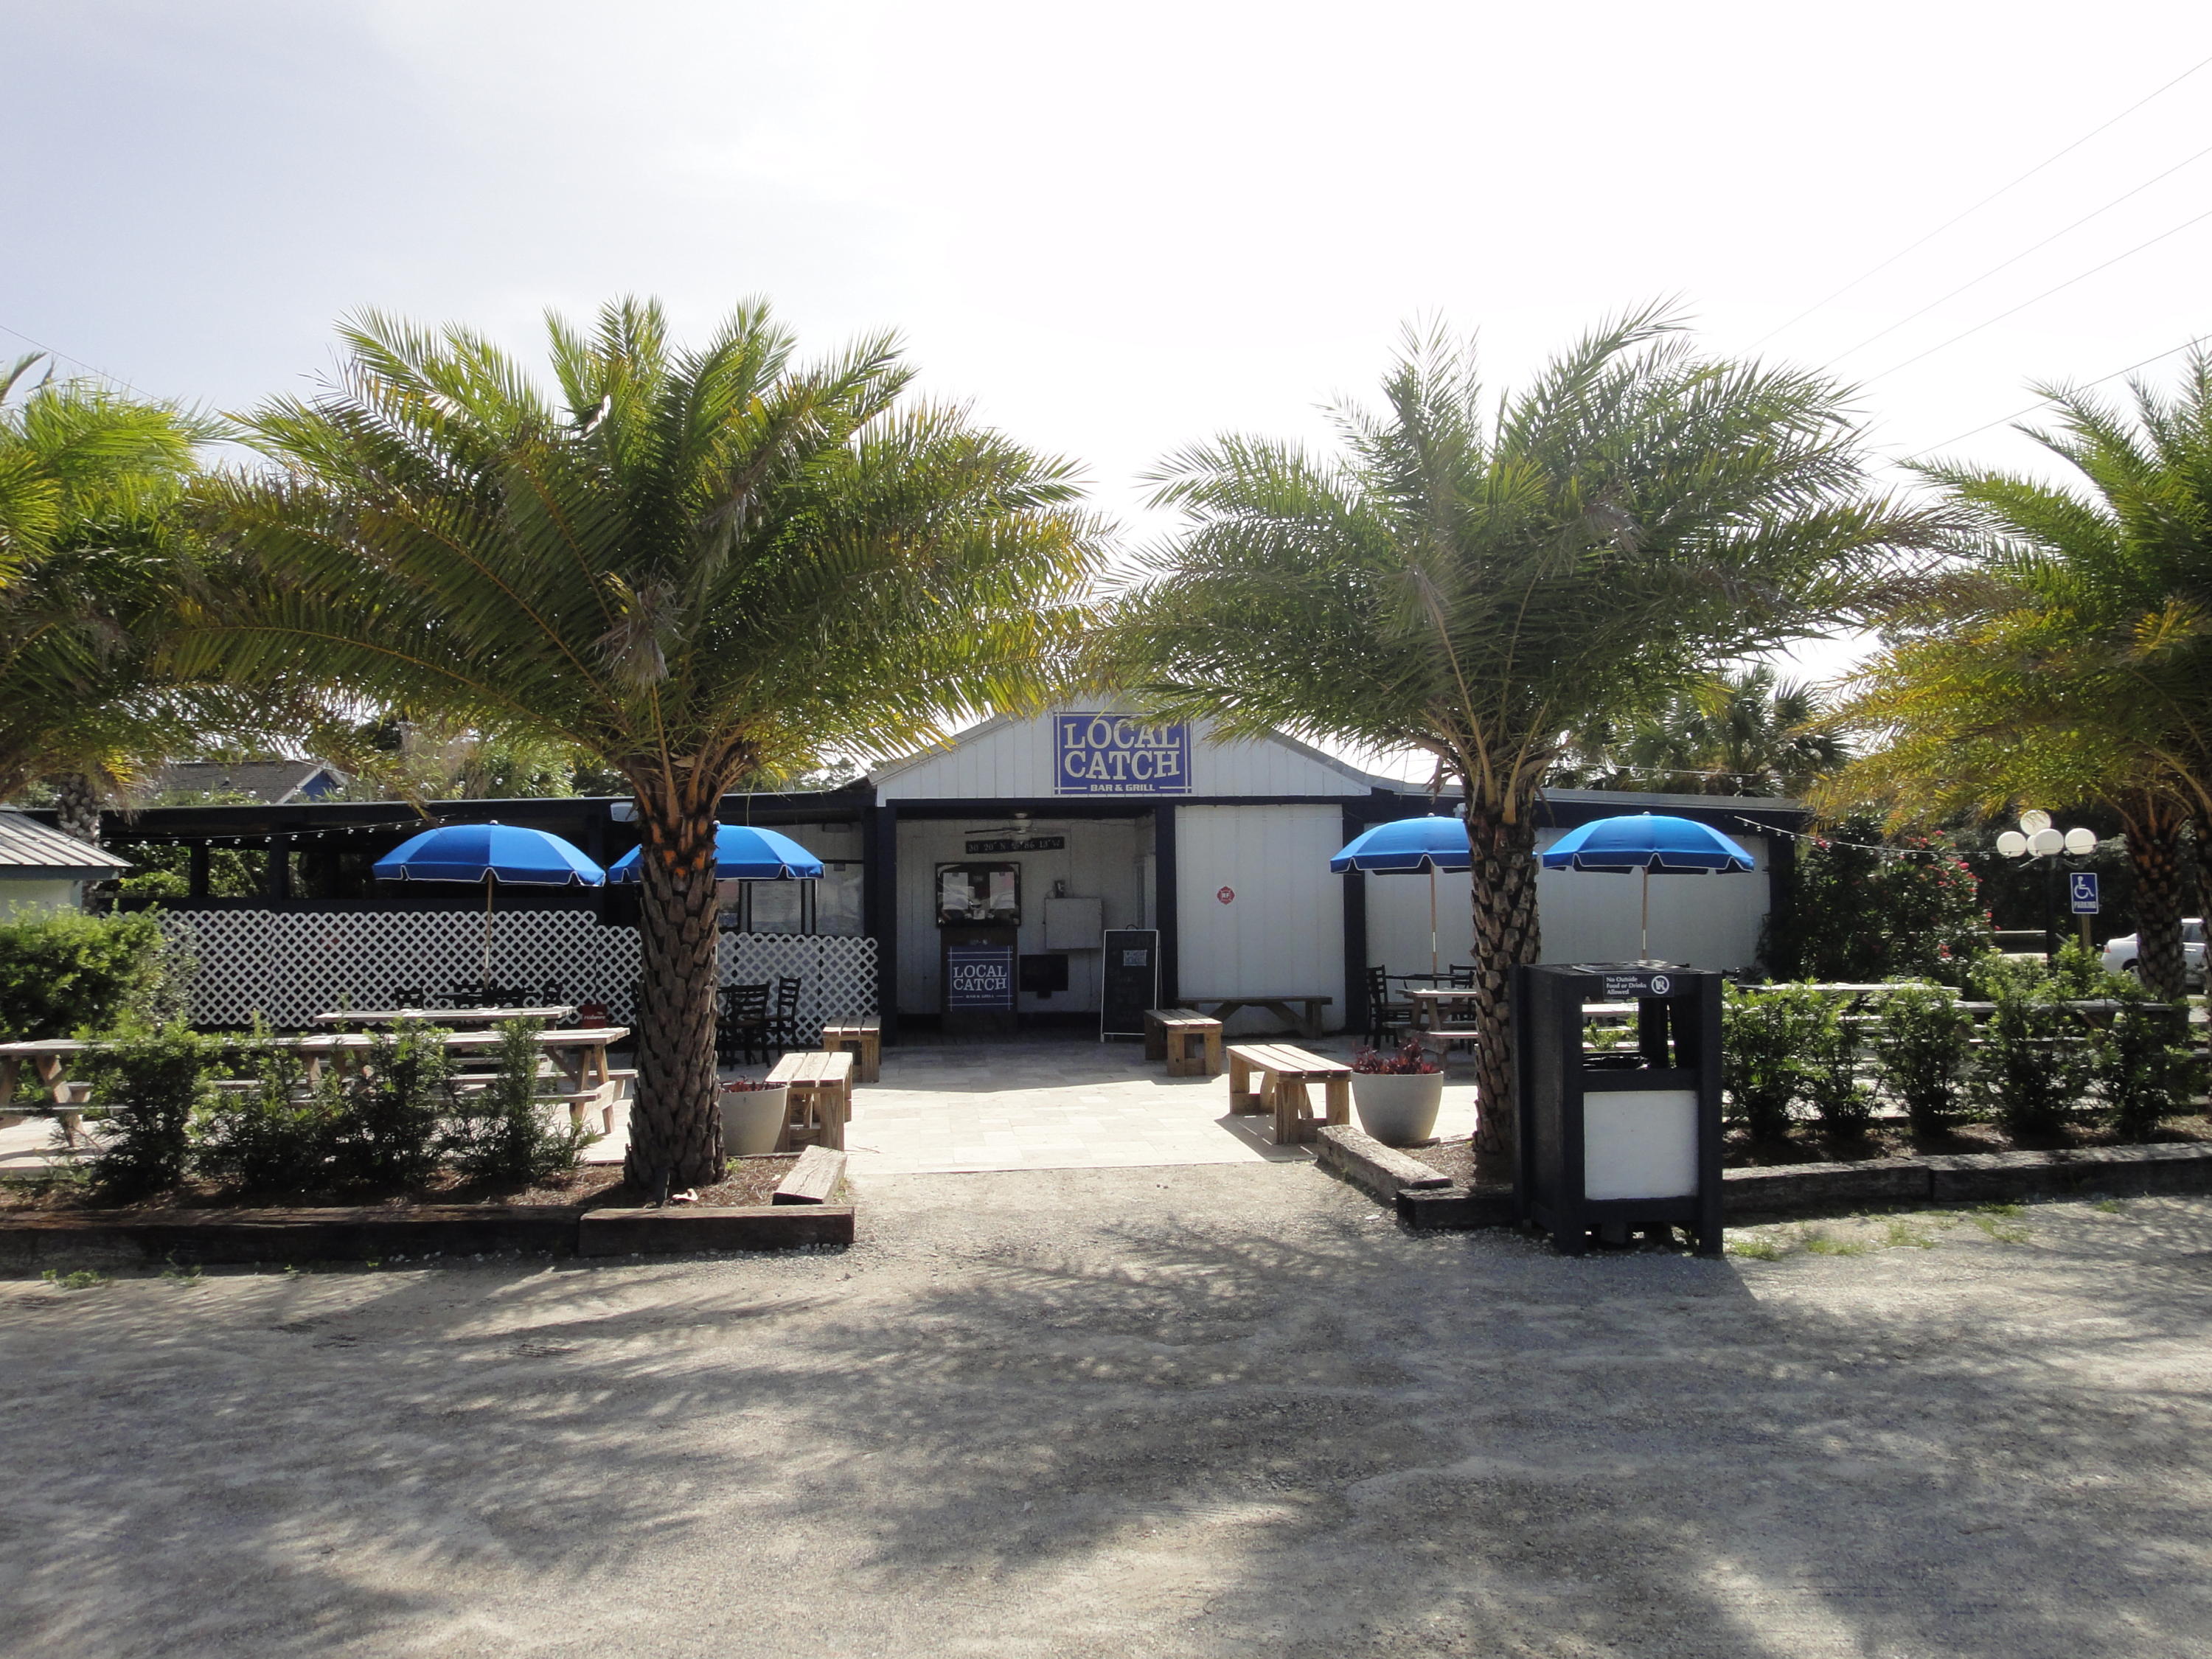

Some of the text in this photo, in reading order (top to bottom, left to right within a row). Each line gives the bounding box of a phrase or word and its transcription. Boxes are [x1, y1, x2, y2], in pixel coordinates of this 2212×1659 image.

[1063, 720, 1180, 749] LOCAL
[1064, 751, 1180, 780] CATCH
[1091, 784, 1113, 792] BAR
[953, 964, 1007, 978] LOCAL
[953, 978, 1007, 991] CATCH
